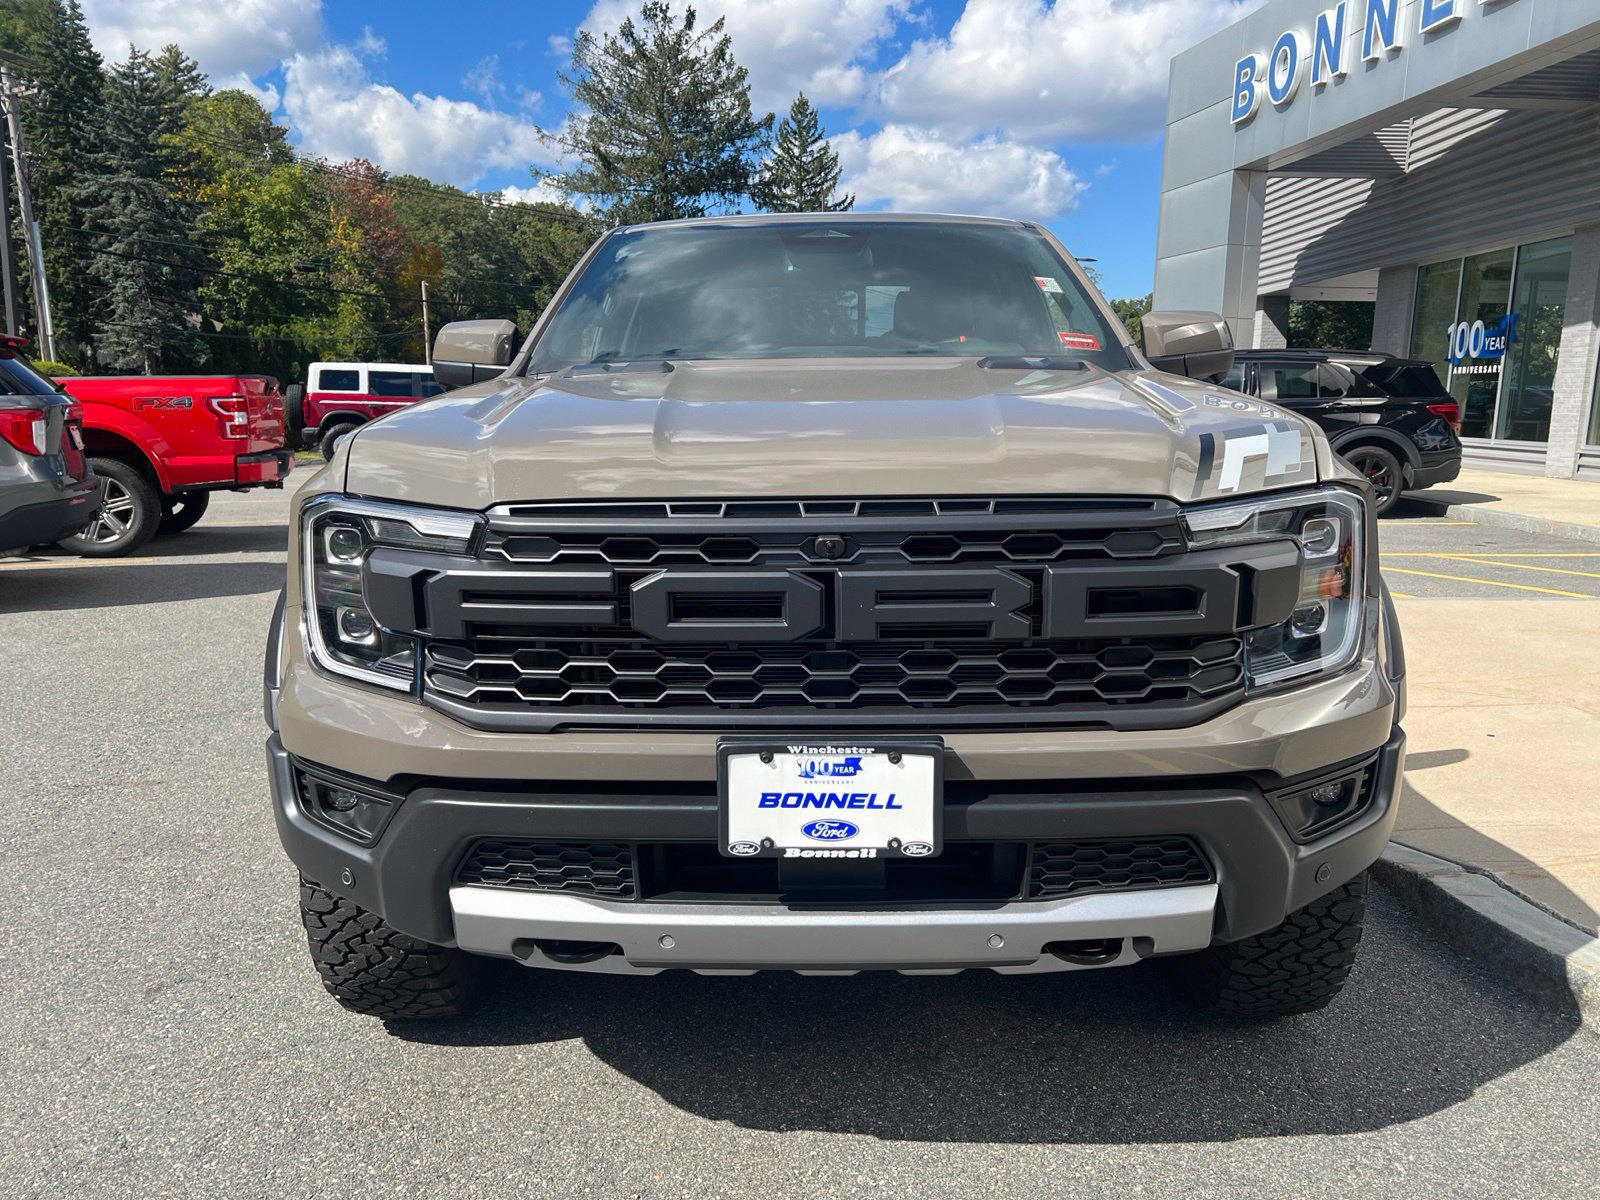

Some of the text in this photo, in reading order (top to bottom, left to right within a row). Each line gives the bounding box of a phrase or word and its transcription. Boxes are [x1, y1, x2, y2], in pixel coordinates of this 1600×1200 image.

[1230, 0, 1520, 124] BONN
[1447, 320, 1506, 359] 100 YEAR
[1453, 365, 1502, 375] ANNIVERSARY
[132, 397, 193, 411] FX4
[424, 566, 1241, 643] FORD
[786, 745, 875, 755] Winchester
[797, 756, 855, 777] 100 YEAR
[758, 792, 903, 810] BONNELL
[809, 820, 851, 839] Ford
[730, 843, 757, 854] Ford
[783, 847, 877, 859] Bonnell
[904, 844, 930, 854] Ford
